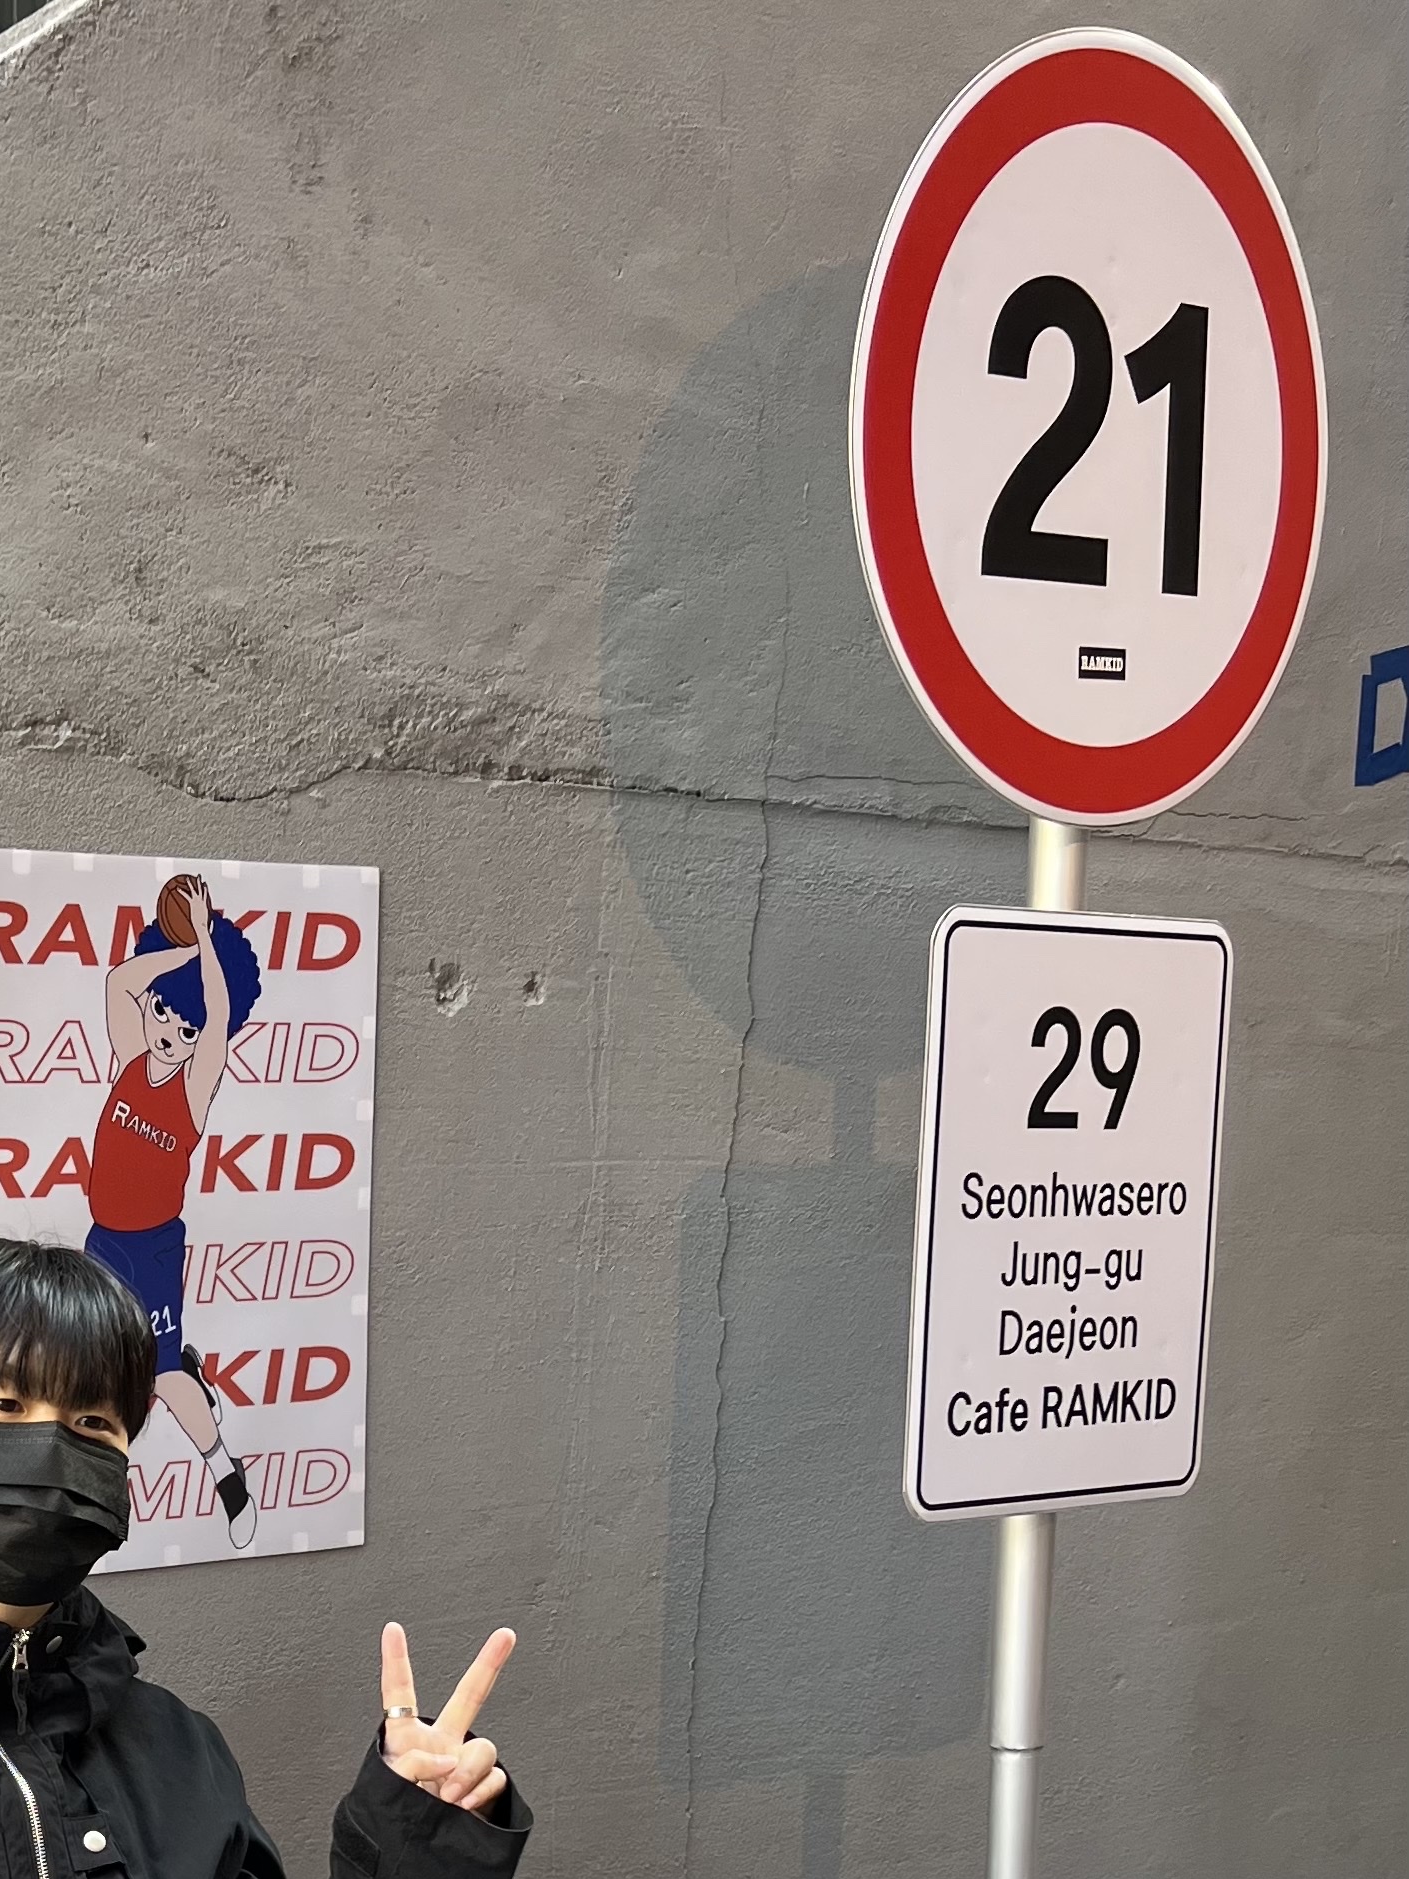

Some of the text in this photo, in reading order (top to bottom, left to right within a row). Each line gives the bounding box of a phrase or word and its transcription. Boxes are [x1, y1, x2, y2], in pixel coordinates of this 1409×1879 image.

[981, 274, 1210, 598] 21
[1080, 655, 1124, 672] RAMKID
[1027, 1006, 1141, 1130] 29
[111, 1100, 179, 1153] RAMKID
[961, 1171, 1188, 1220] Seonhwasero
[1001, 1241, 1143, 1292] Jung-gu
[151, 1305, 177, 1337] 21
[998, 1305, 1138, 1360] Daejeon
[947, 1378, 1177, 1437] Cafe RAMKID
